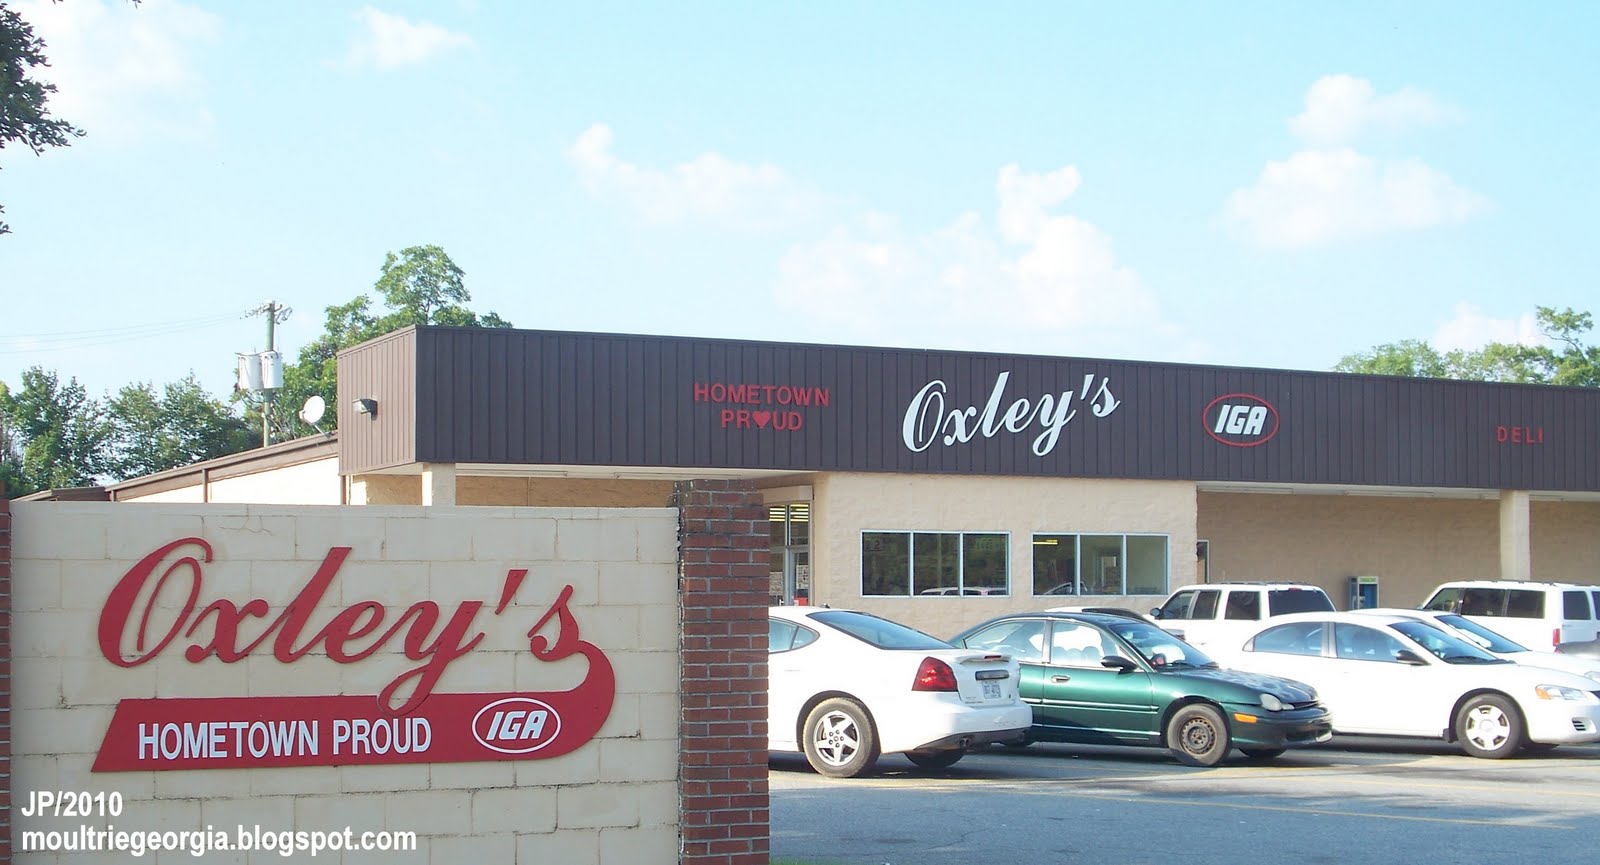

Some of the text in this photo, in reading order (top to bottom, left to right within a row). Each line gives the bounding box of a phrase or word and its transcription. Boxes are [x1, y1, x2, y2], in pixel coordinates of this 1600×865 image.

[693, 383, 831, 408] HOMETOWN
[902, 371, 1121, 456] Oxley's
[1214, 404, 1269, 435] IGA
[1496, 425, 1545, 445] DELI
[98, 537, 581, 716] Oxley's
[137, 716, 433, 761] HOMETOWN PROUD
[485, 709, 549, 742] IGA
